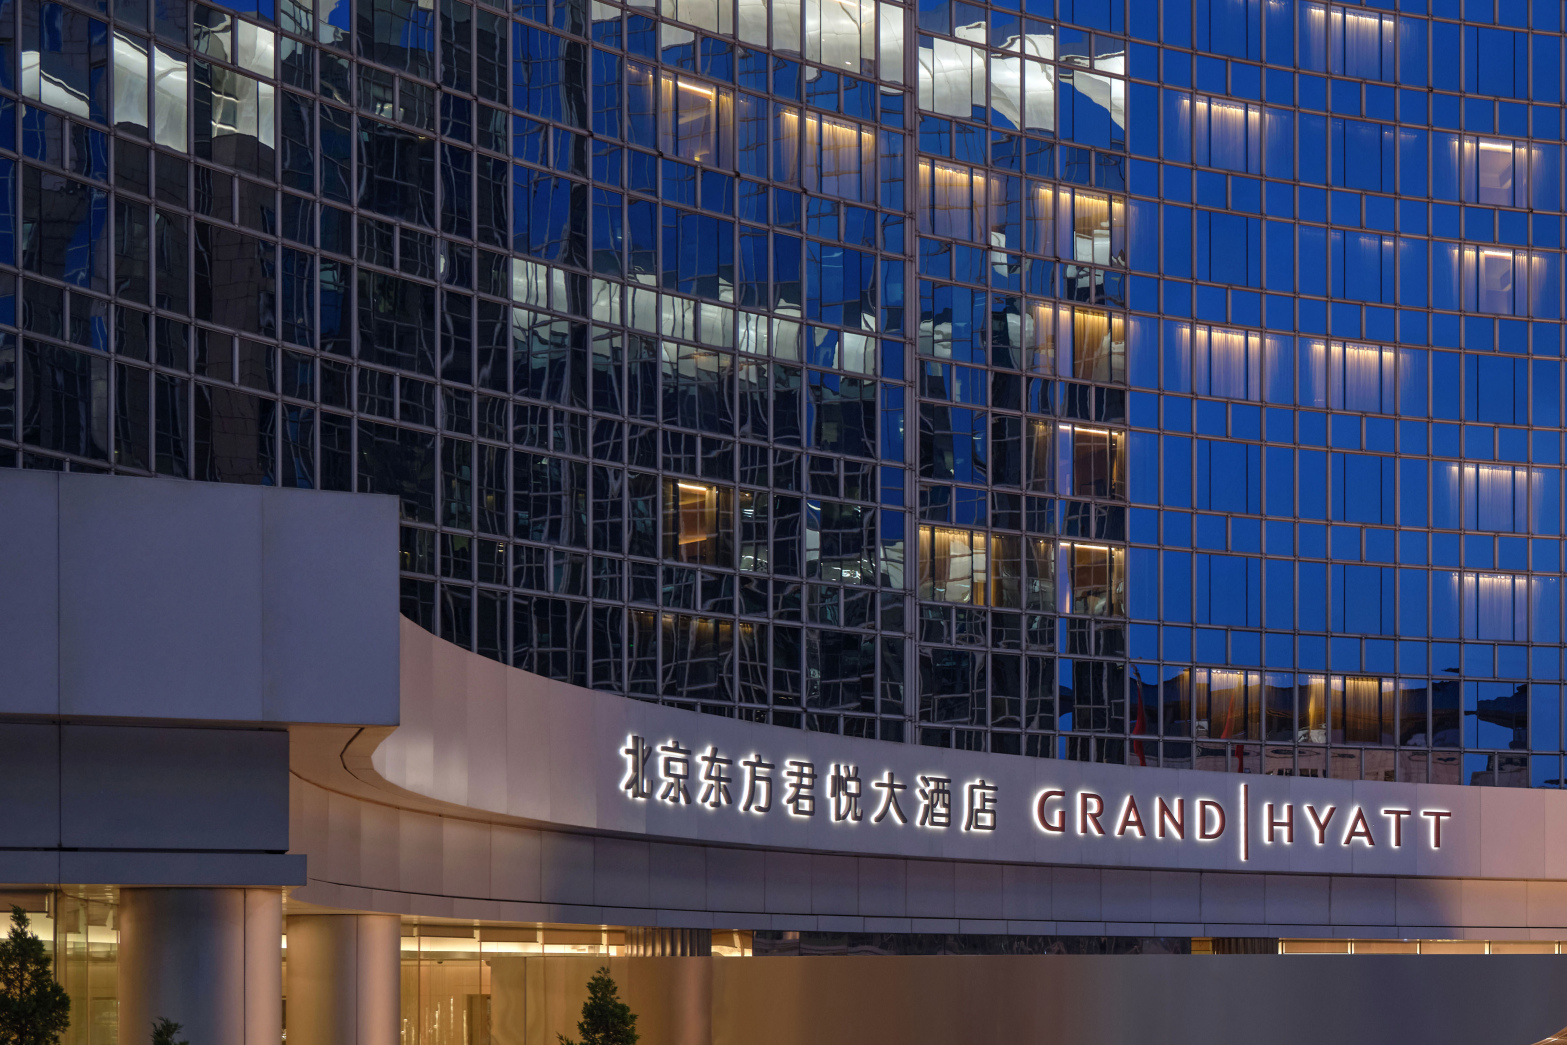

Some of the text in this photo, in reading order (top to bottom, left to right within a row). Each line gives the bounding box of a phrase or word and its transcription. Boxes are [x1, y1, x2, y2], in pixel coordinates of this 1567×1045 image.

[621, 735, 999, 831] 北京东方君悦大酒店
[1035, 789, 1452, 849] GRAND HYATT
